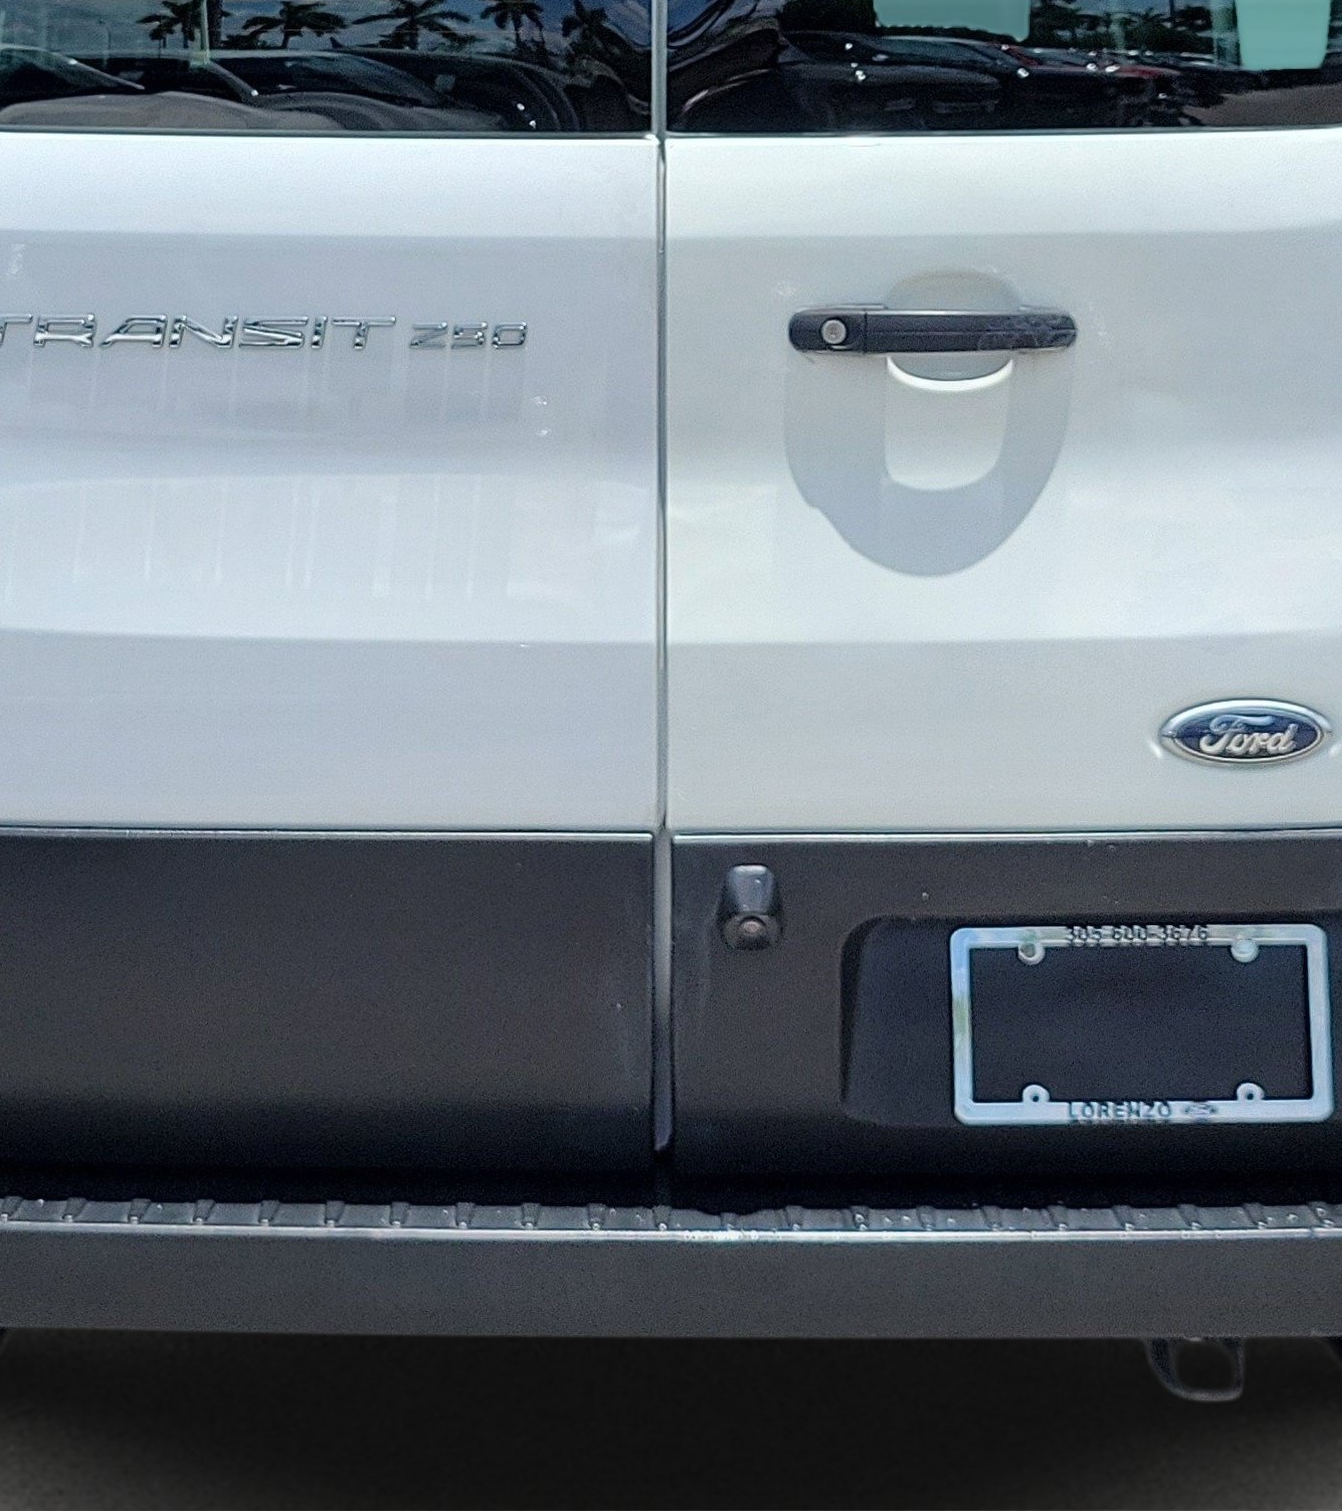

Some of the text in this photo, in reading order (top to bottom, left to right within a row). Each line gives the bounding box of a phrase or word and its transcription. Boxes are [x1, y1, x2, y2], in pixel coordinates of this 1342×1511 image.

[408, 322, 528, 350] 250
[1199, 714, 1298, 756] Ford
[1068, 1101, 1172, 1120] LORENZO
